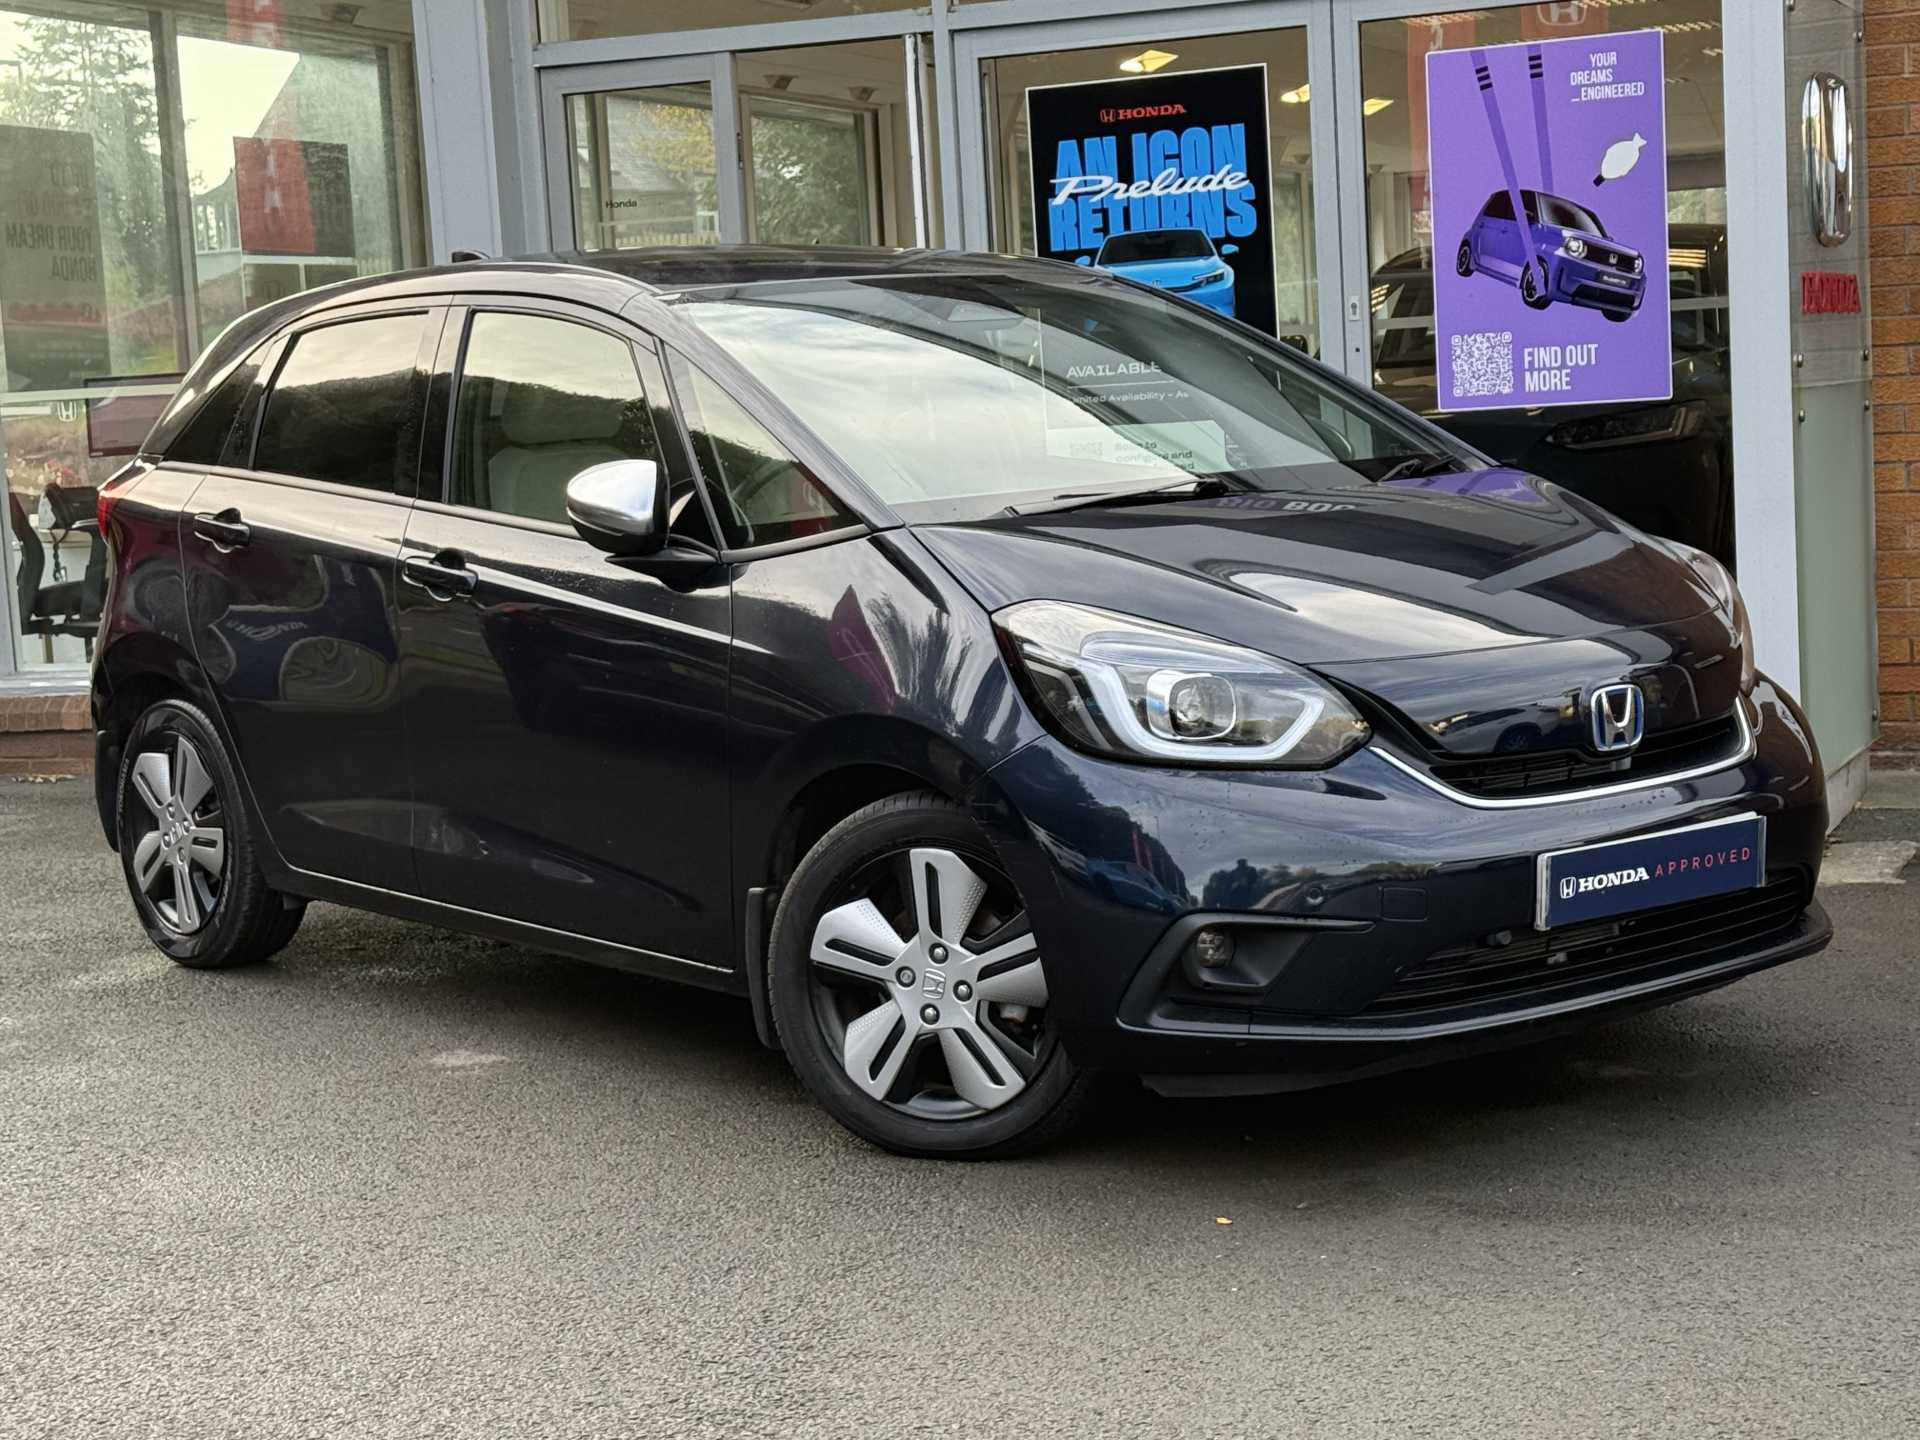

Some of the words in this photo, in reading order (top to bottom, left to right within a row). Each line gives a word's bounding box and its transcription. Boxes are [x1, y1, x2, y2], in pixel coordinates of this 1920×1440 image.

[1590, 52, 1617, 67] YOUR
[1570, 69, 1613, 86] DREAMS
[1118, 104, 1187, 120] HONDA
[1055, 136, 1119, 195] AN
[1131, 123, 1248, 182] ICON
[1050, 163, 1250, 206] Prelude
[605, 198, 638, 209] Honda
[1048, 182, 1258, 252] RETURNS
[1523, 346, 1562, 369] FIND
[1565, 343, 1599, 366] OUT
[1524, 368, 1572, 393] MORE
[1577, 866, 1650, 893] HONDA
[1654, 846, 1751, 878] APPROVED
